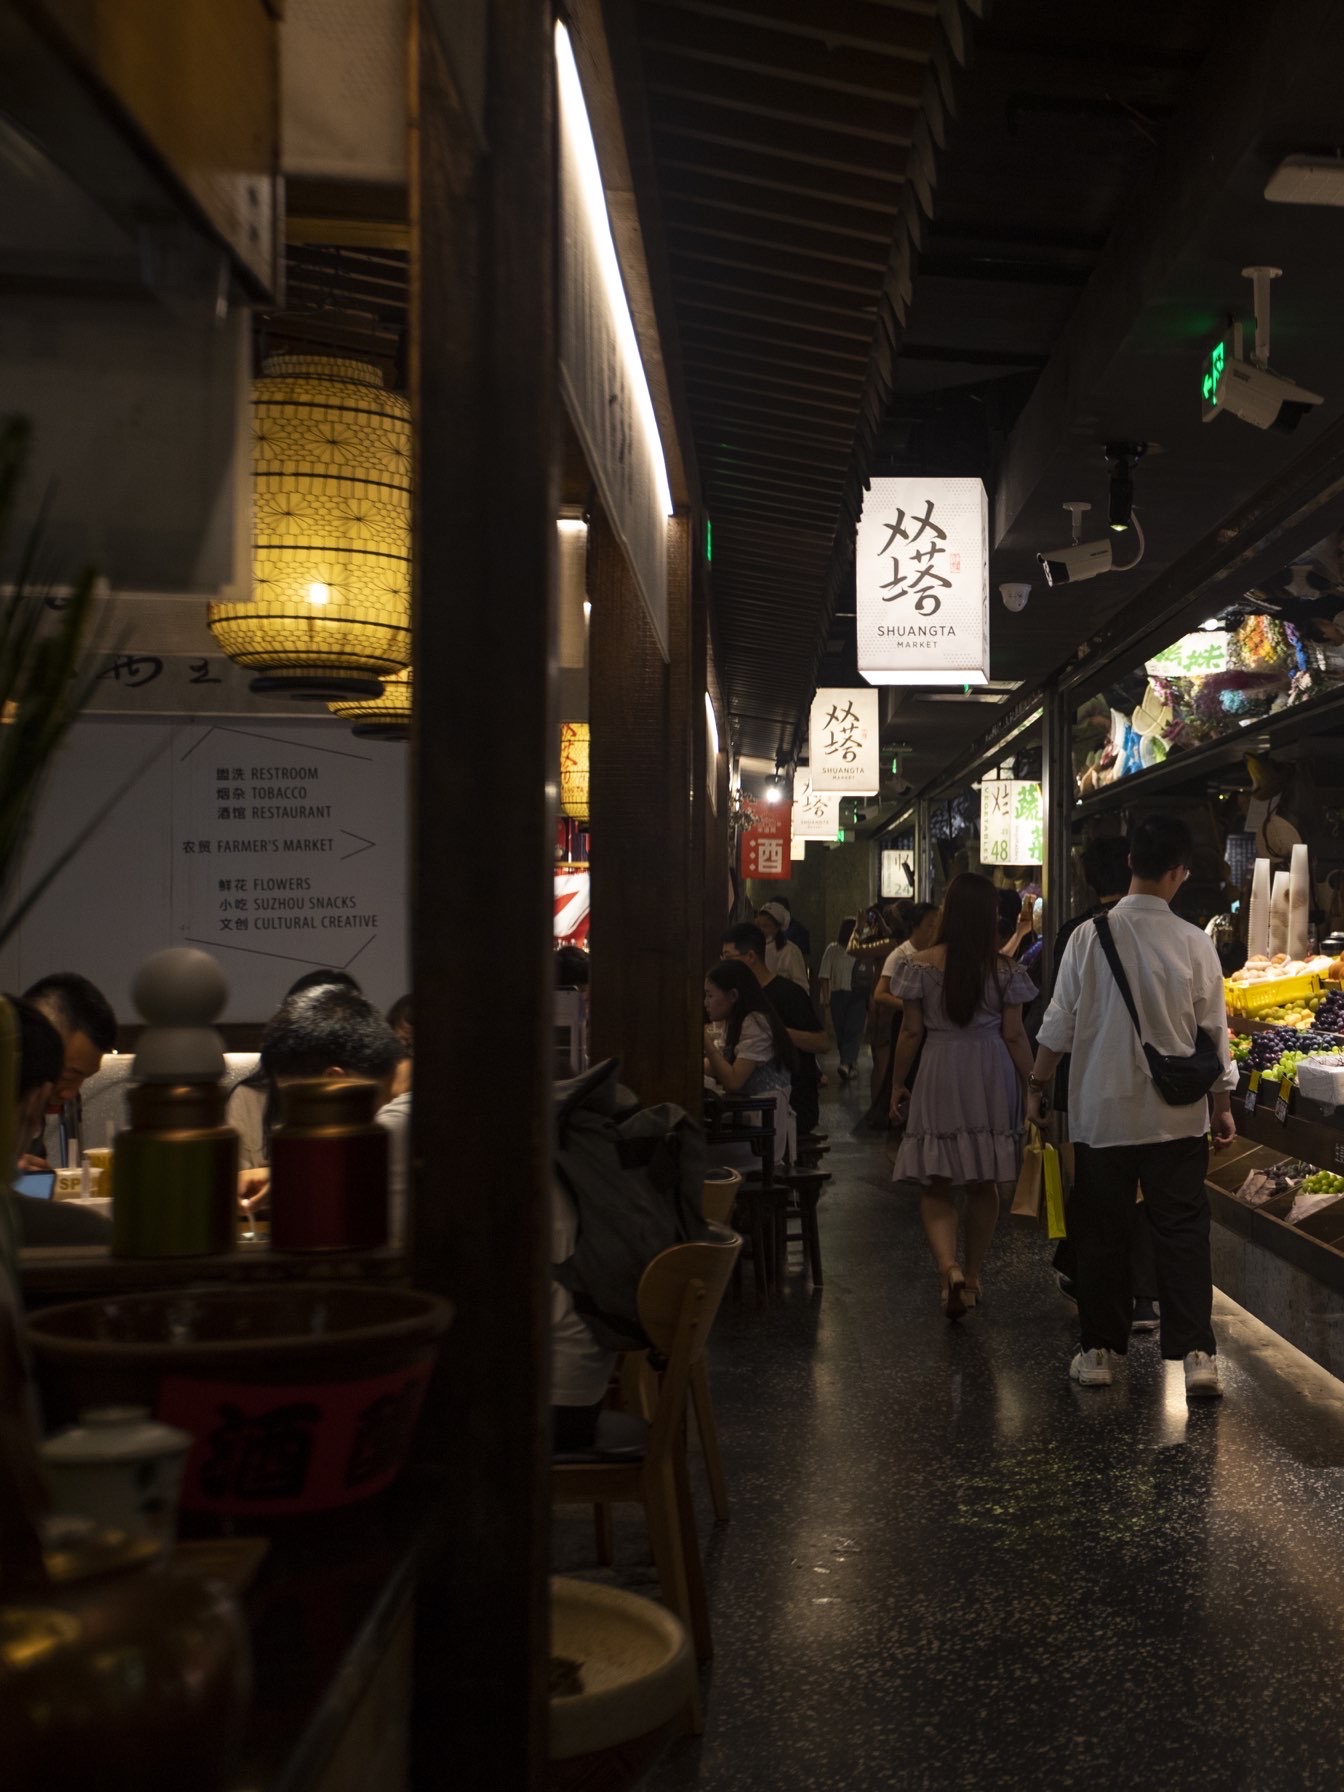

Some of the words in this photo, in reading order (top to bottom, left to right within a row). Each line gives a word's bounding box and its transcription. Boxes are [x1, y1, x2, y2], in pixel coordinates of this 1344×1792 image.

[877, 625, 956, 637] SHUANGTA
[896, 641, 938, 649] MARKET
[251, 767, 319, 780] RESTROOM
[252, 786, 307, 800] TOBACCO
[217, 806, 246, 820] 酒馆
[252, 805, 332, 819] RESTAURANT
[183, 841, 212, 854] 农贸
[217, 839, 279, 853] FARMER'S
[284, 839, 334, 852] MARKET
[991, 840, 1008, 861] 48
[219, 879, 248, 892] 鲜花
[253, 878, 311, 891] FLOWERS
[219, 898, 248, 912] 小吃
[254, 897, 305, 911] SUZHOU
[309, 896, 357, 910] SNACKS
[220, 918, 249, 931] 文创
[254, 917, 316, 930] CULTURAL
[321, 915, 379, 928] CREATIVE
